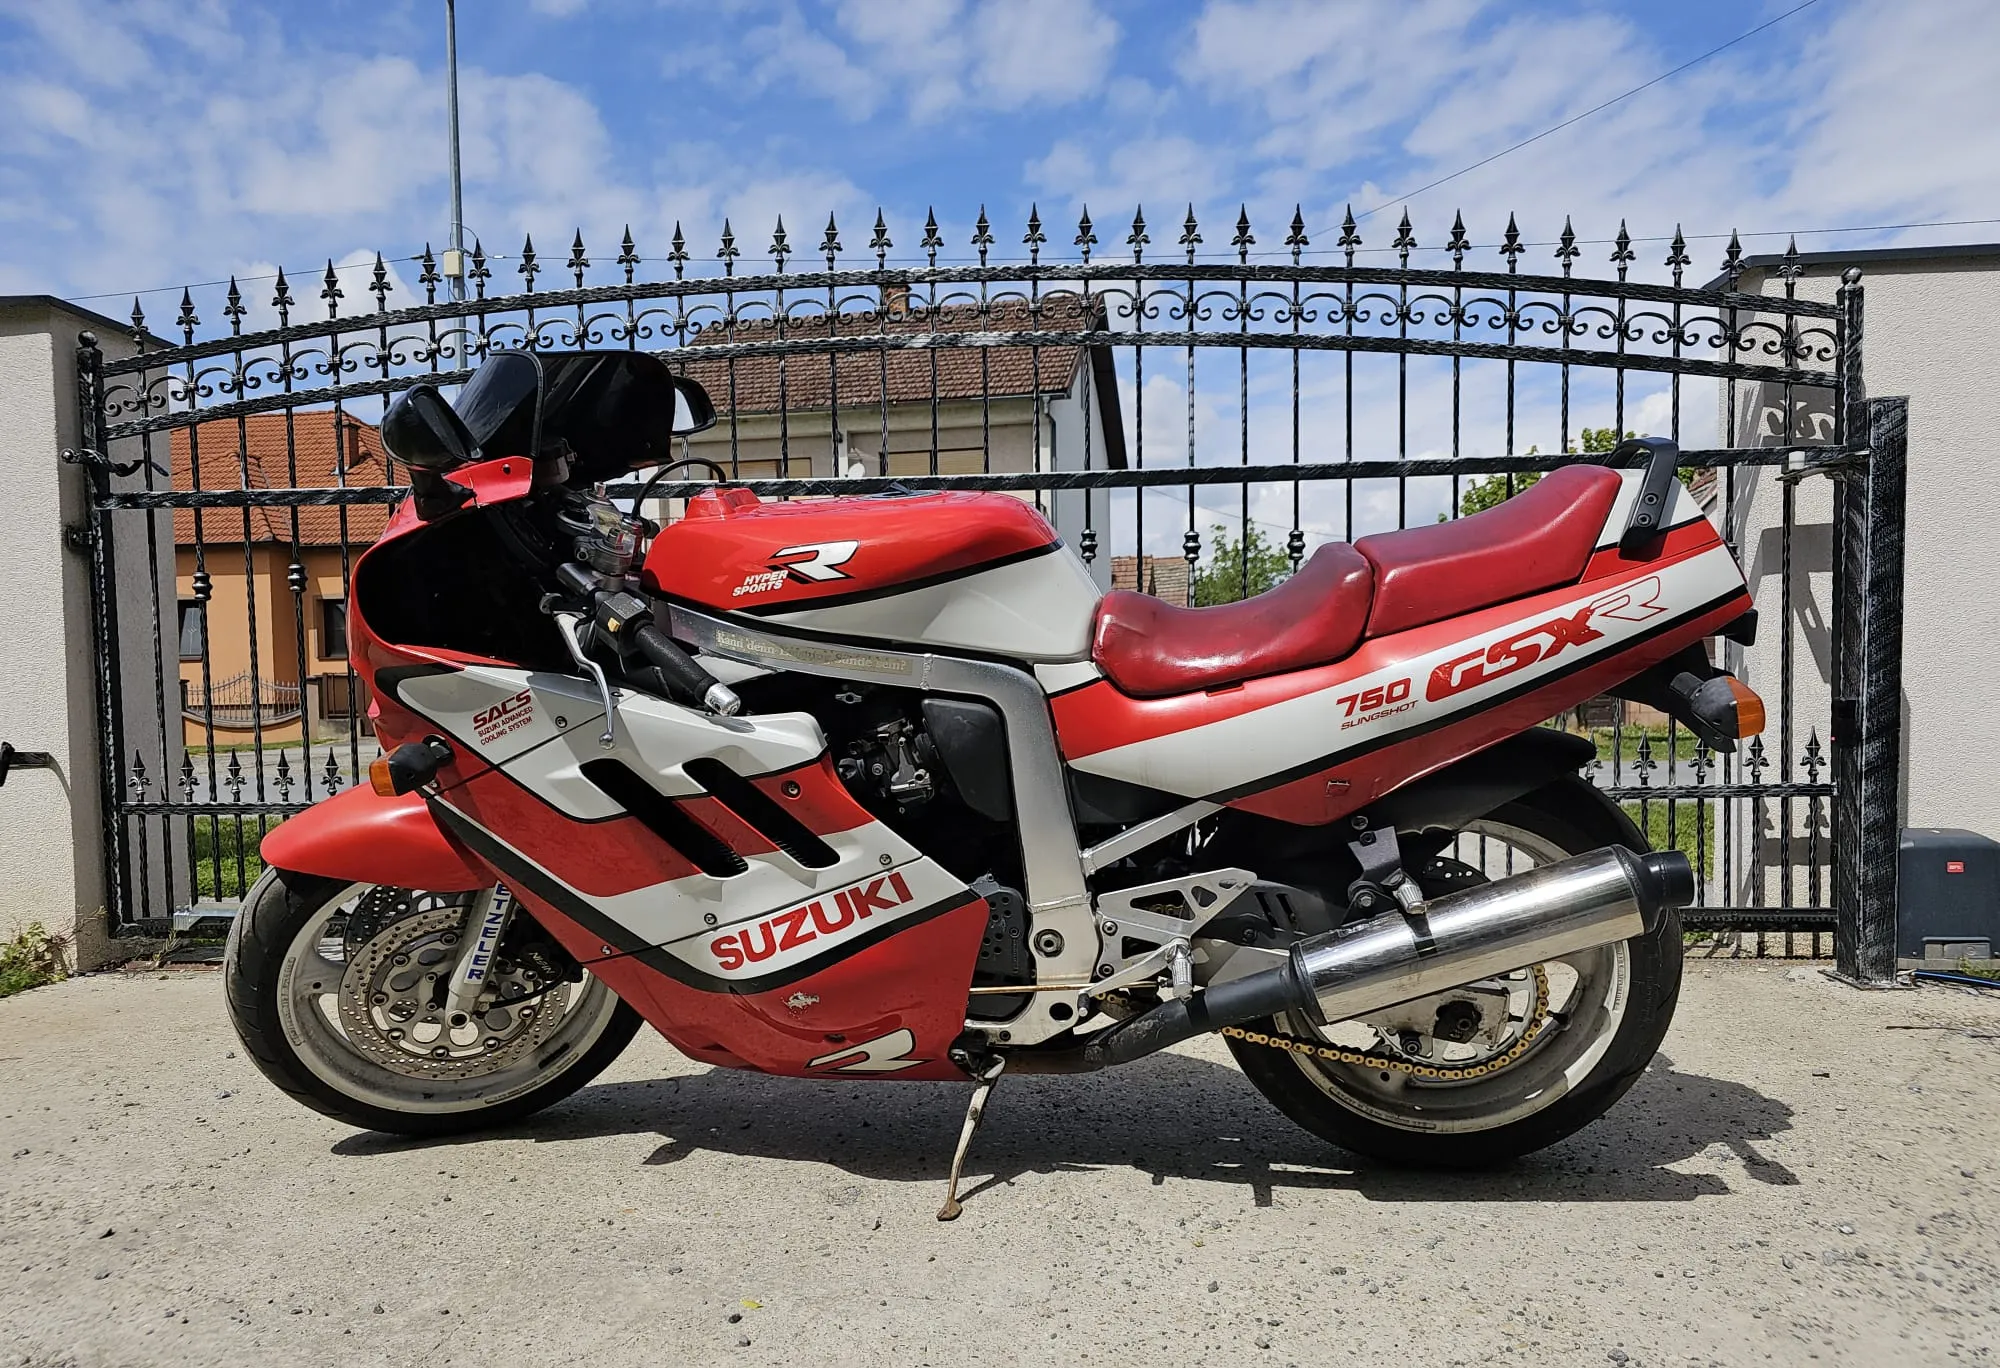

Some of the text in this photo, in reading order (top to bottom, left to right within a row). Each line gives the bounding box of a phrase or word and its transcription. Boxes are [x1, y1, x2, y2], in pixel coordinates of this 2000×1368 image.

[767, 539, 860, 582] R
[732, 580, 783, 597] SPORTS
[743, 570, 788, 586] HYPER
[717, 630, 744, 647] Kann
[473, 688, 531, 731] SACS
[1336, 677, 1412, 717] 750
[478, 706, 533, 737] SUZUKI ADVANCED
[1341, 700, 1418, 730] SLINGSHOT
[480, 716, 533, 745] COOLING SYSTEM
[710, 871, 914, 970] SUZUKI
